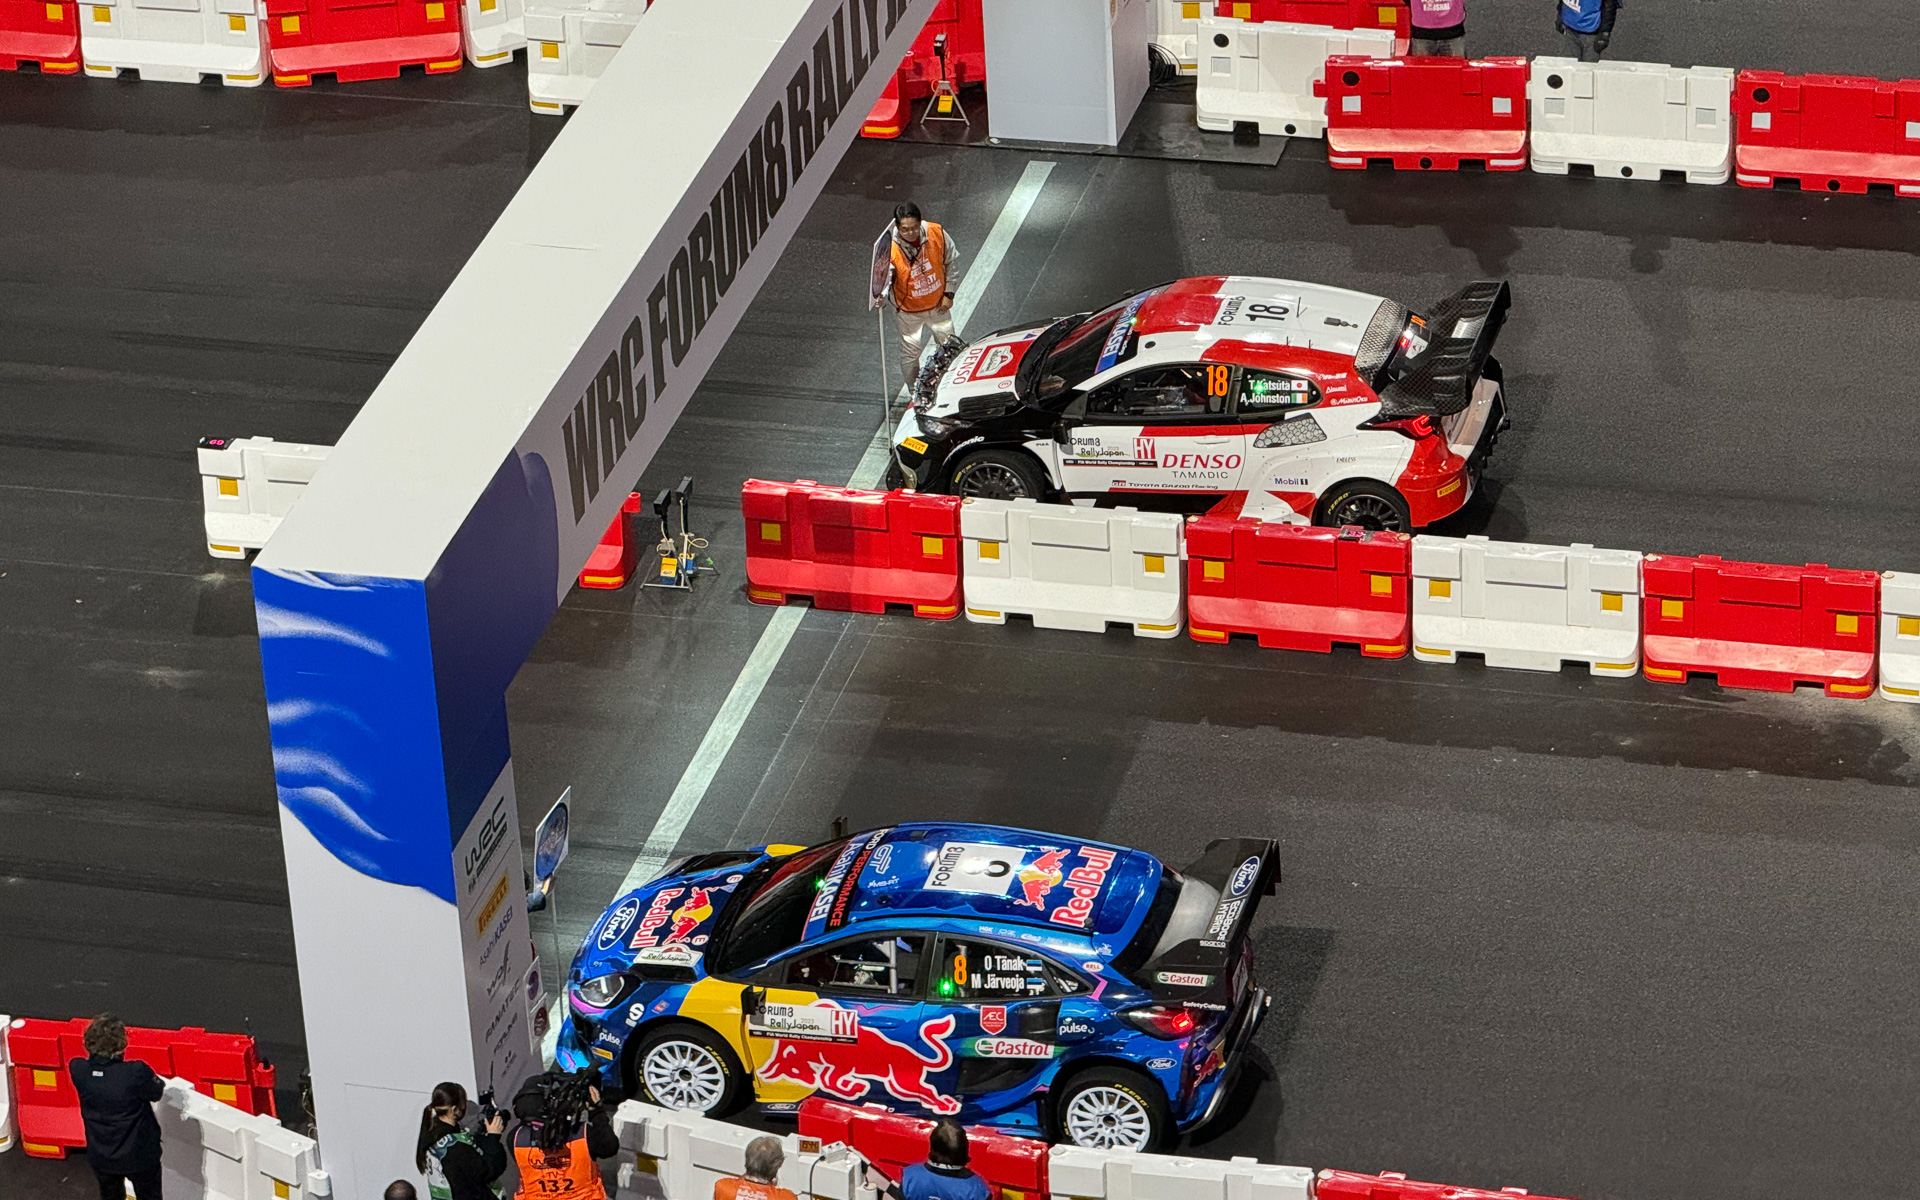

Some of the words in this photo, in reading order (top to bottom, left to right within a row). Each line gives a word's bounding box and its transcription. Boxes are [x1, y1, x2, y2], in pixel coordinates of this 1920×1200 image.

[561, 315, 647, 526] WRC
[646, 100, 788, 404] FORUM8
[1245, 304, 1289, 321] 18
[953, 348, 984, 385] DENSO
[1206, 365, 1228, 397] 18
[1133, 438, 1156, 459] HY
[1162, 454, 1242, 469] DENSO
[1172, 471, 1229, 479] TAMADIC
[865, 829, 889, 850] FORD
[809, 843, 864, 922] AsahiKASEI
[1232, 863, 1258, 890] Ford
[830, 850, 873, 926] PERFORMANCE
[602, 905, 635, 942] Ford
[1210, 903, 1231, 934] HYBRID
[954, 954, 967, 985] 8
[994, 955, 1024, 971] Tänak
[971, 973, 981, 989] M
[984, 974, 1025, 991] Järveoja
[1170, 974, 1204, 985] Castrol
[1182, 1001, 1226, 1011] SafetyCulture
[831, 1010, 856, 1036] HY
[1059, 1023, 1088, 1035] pulse
[599, 1032, 621, 1046] pulse
[995, 1040, 1050, 1056] Castrol
[1150, 1058, 1172, 1069] Ford
[538, 1178, 575, 1192] 132
